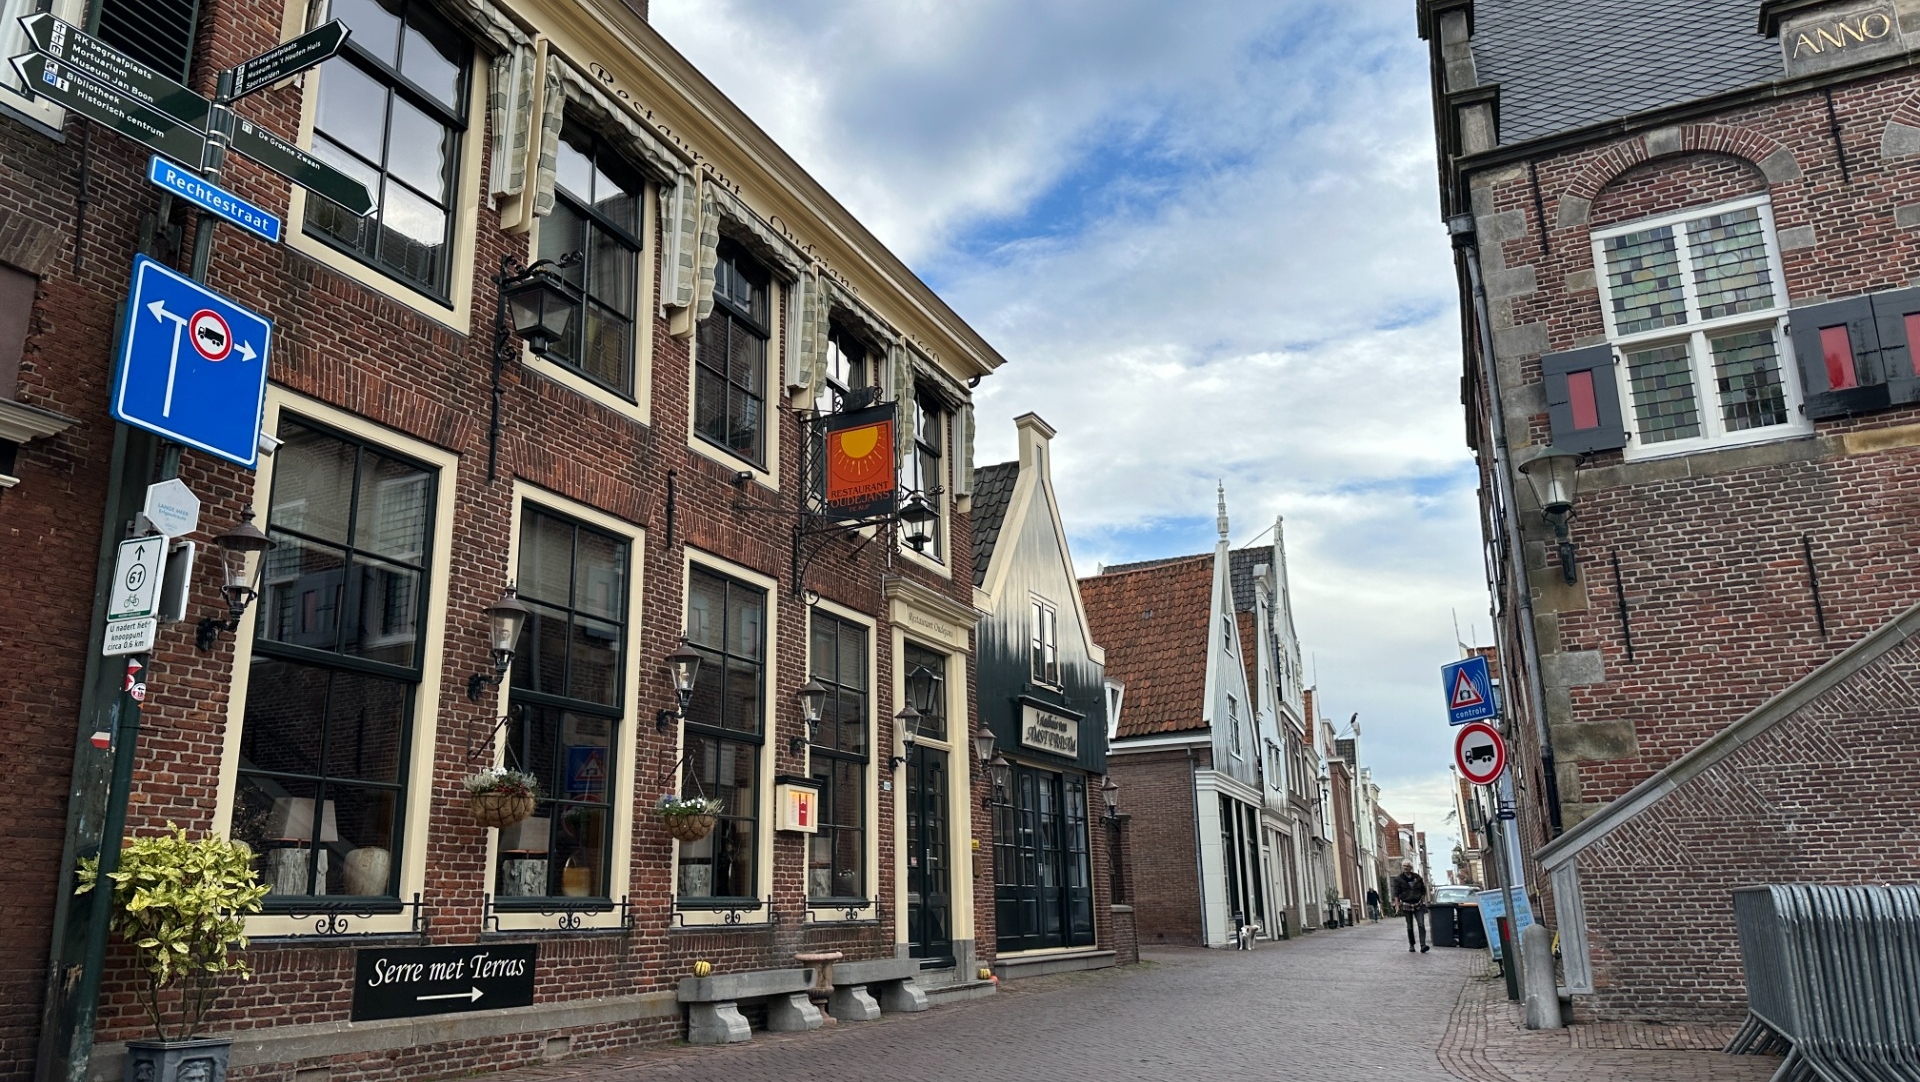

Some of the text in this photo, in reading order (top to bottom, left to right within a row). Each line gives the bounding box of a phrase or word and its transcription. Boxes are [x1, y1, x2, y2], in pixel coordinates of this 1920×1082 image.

[1793, 13, 1890, 59] ANNO
[72, 44, 128, 78] Mortuarium
[74, 33, 152, 80] RK begraafplaats
[247, 64, 271, 79] Museum
[272, 60, 278, 68] in
[284, 48, 306, 62] Houten
[307, 41, 321, 52] Huis
[248, 43, 297, 69] NH begraafplaats
[66, 72, 120, 104] Bibliotheek
[70, 54, 154, 103] Museum Jan Boon
[245, 70, 280, 90] Sportvelden
[77, 89, 165, 138] Historisch centrum
[258, 131, 320, 170] De Groene Zwaan
[166, 169, 269, 231] Rechtestraat
[830, 491, 890, 508] OUDEJANS
[831, 481, 889, 498] RESTAURANT
[129, 570, 143, 584] 61
[109, 621, 148, 633] U nadert het
[111, 631, 144, 642] knooppunt
[107, 643, 122, 651] circa
[134, 639, 144, 648] km
[1455, 706, 1487, 719] controle
[368, 951, 526, 987] Serre met Terras
